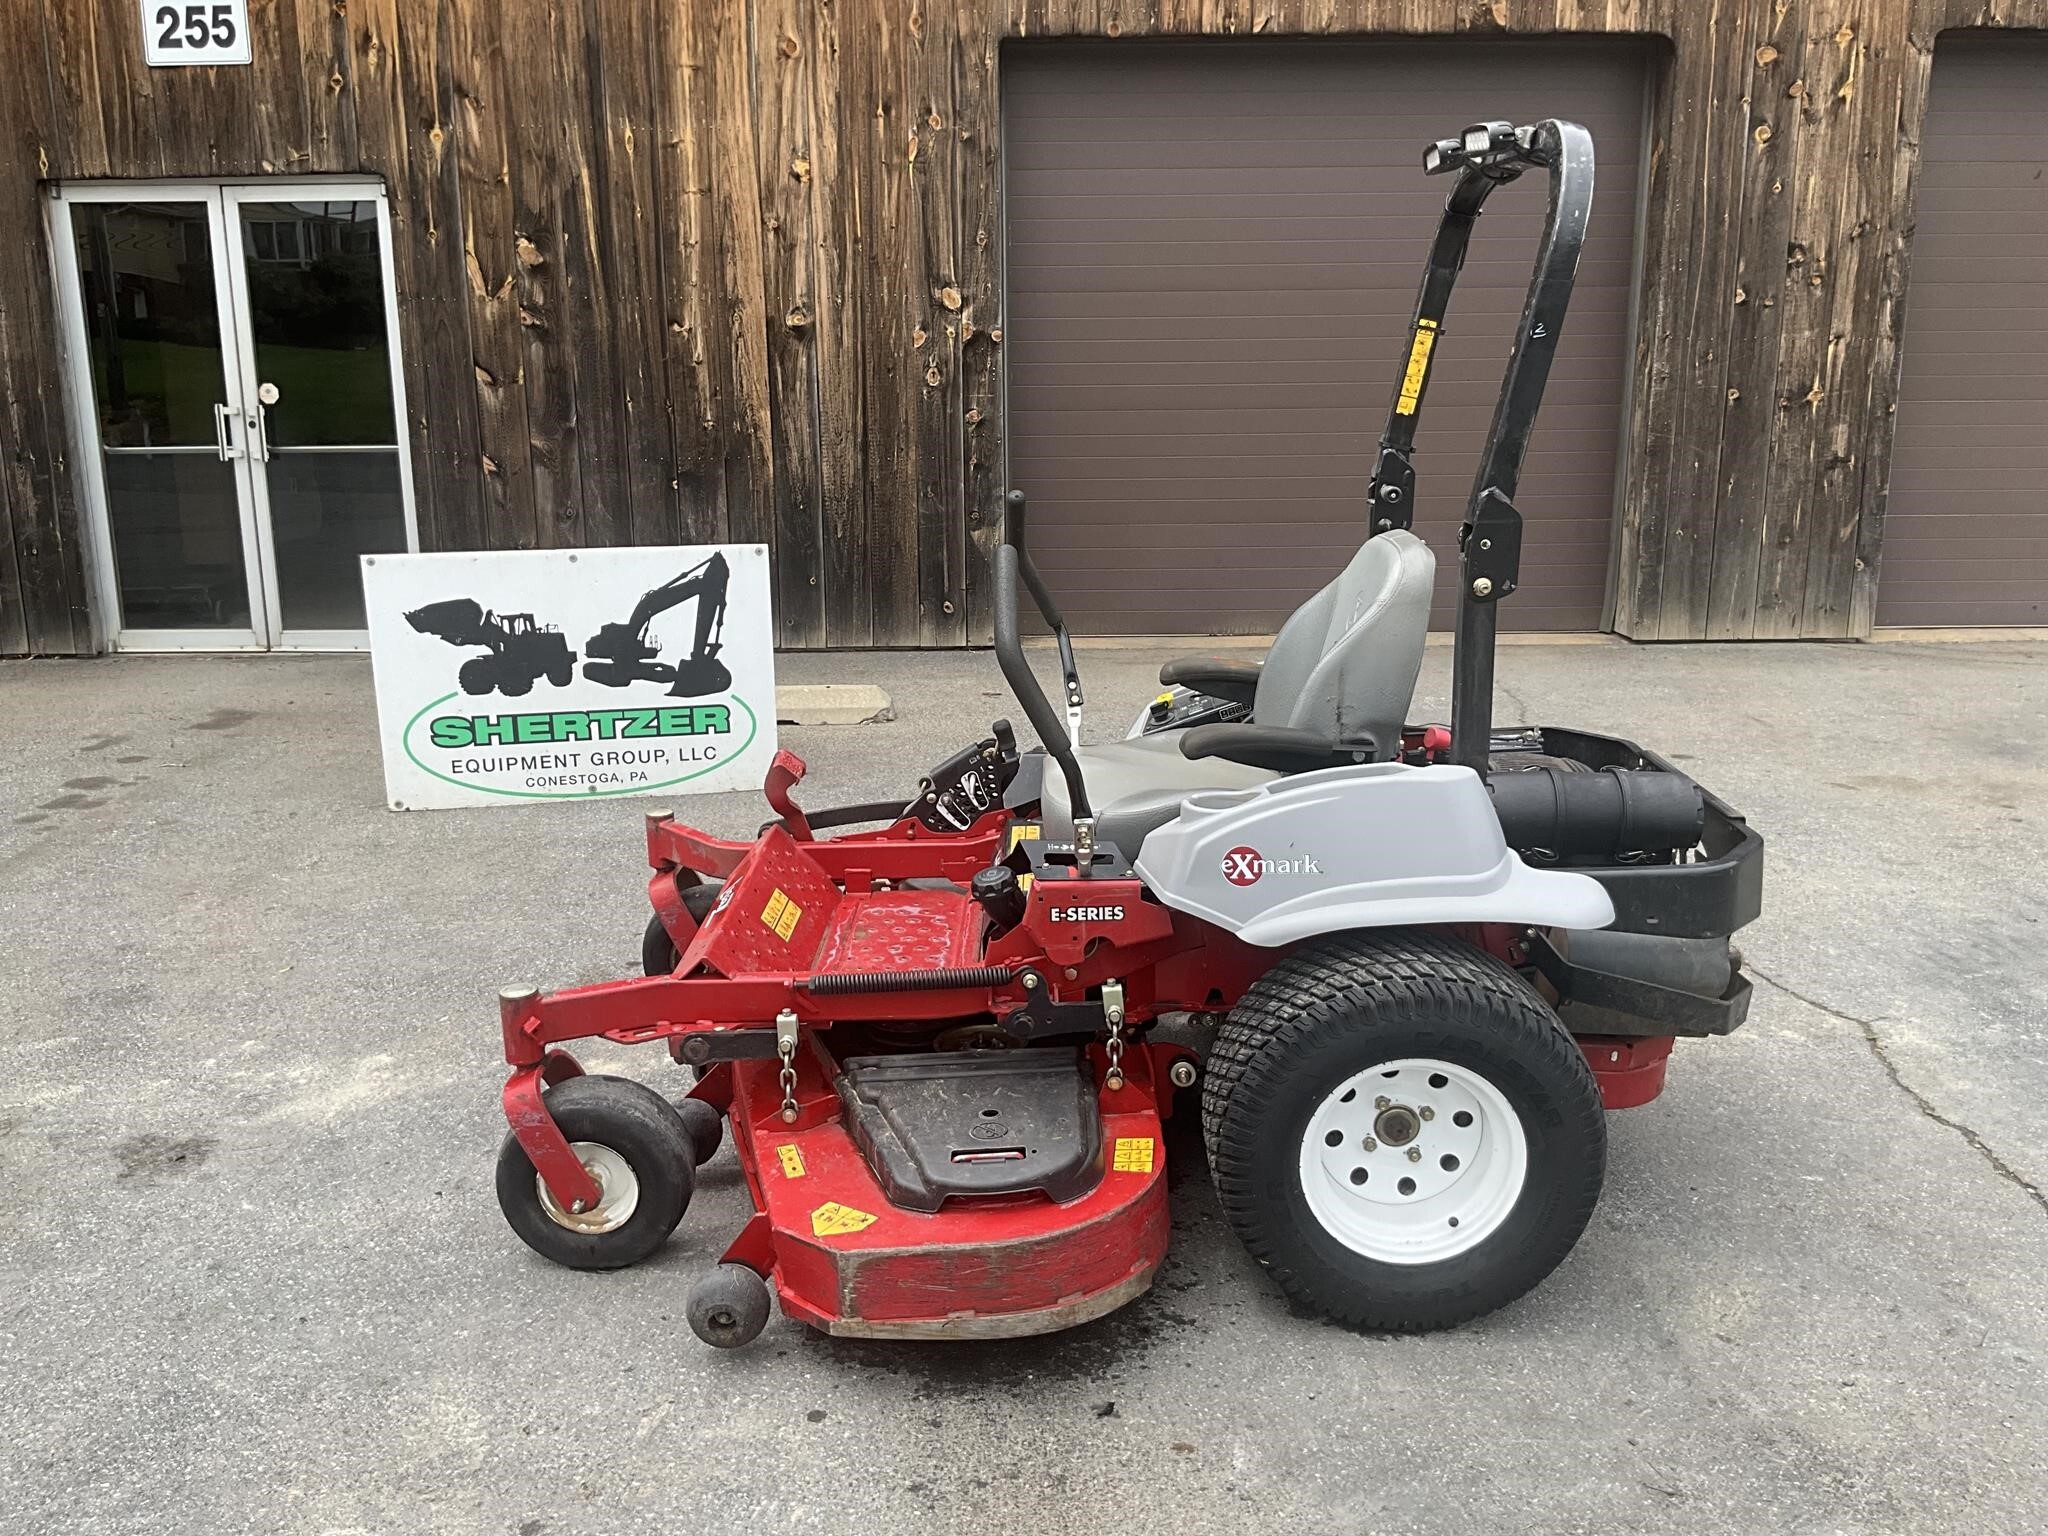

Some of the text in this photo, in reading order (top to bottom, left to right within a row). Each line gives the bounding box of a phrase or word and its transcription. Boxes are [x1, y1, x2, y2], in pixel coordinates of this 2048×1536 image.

[156, 5, 236, 48] 255
[430, 703, 731, 748] SHERTZER
[451, 746, 718, 773] EQUIPMENT GROUP, LLC
[525, 771, 648, 787] CONESTOGA, PA
[1050, 906, 1125, 922] E-SERIES
